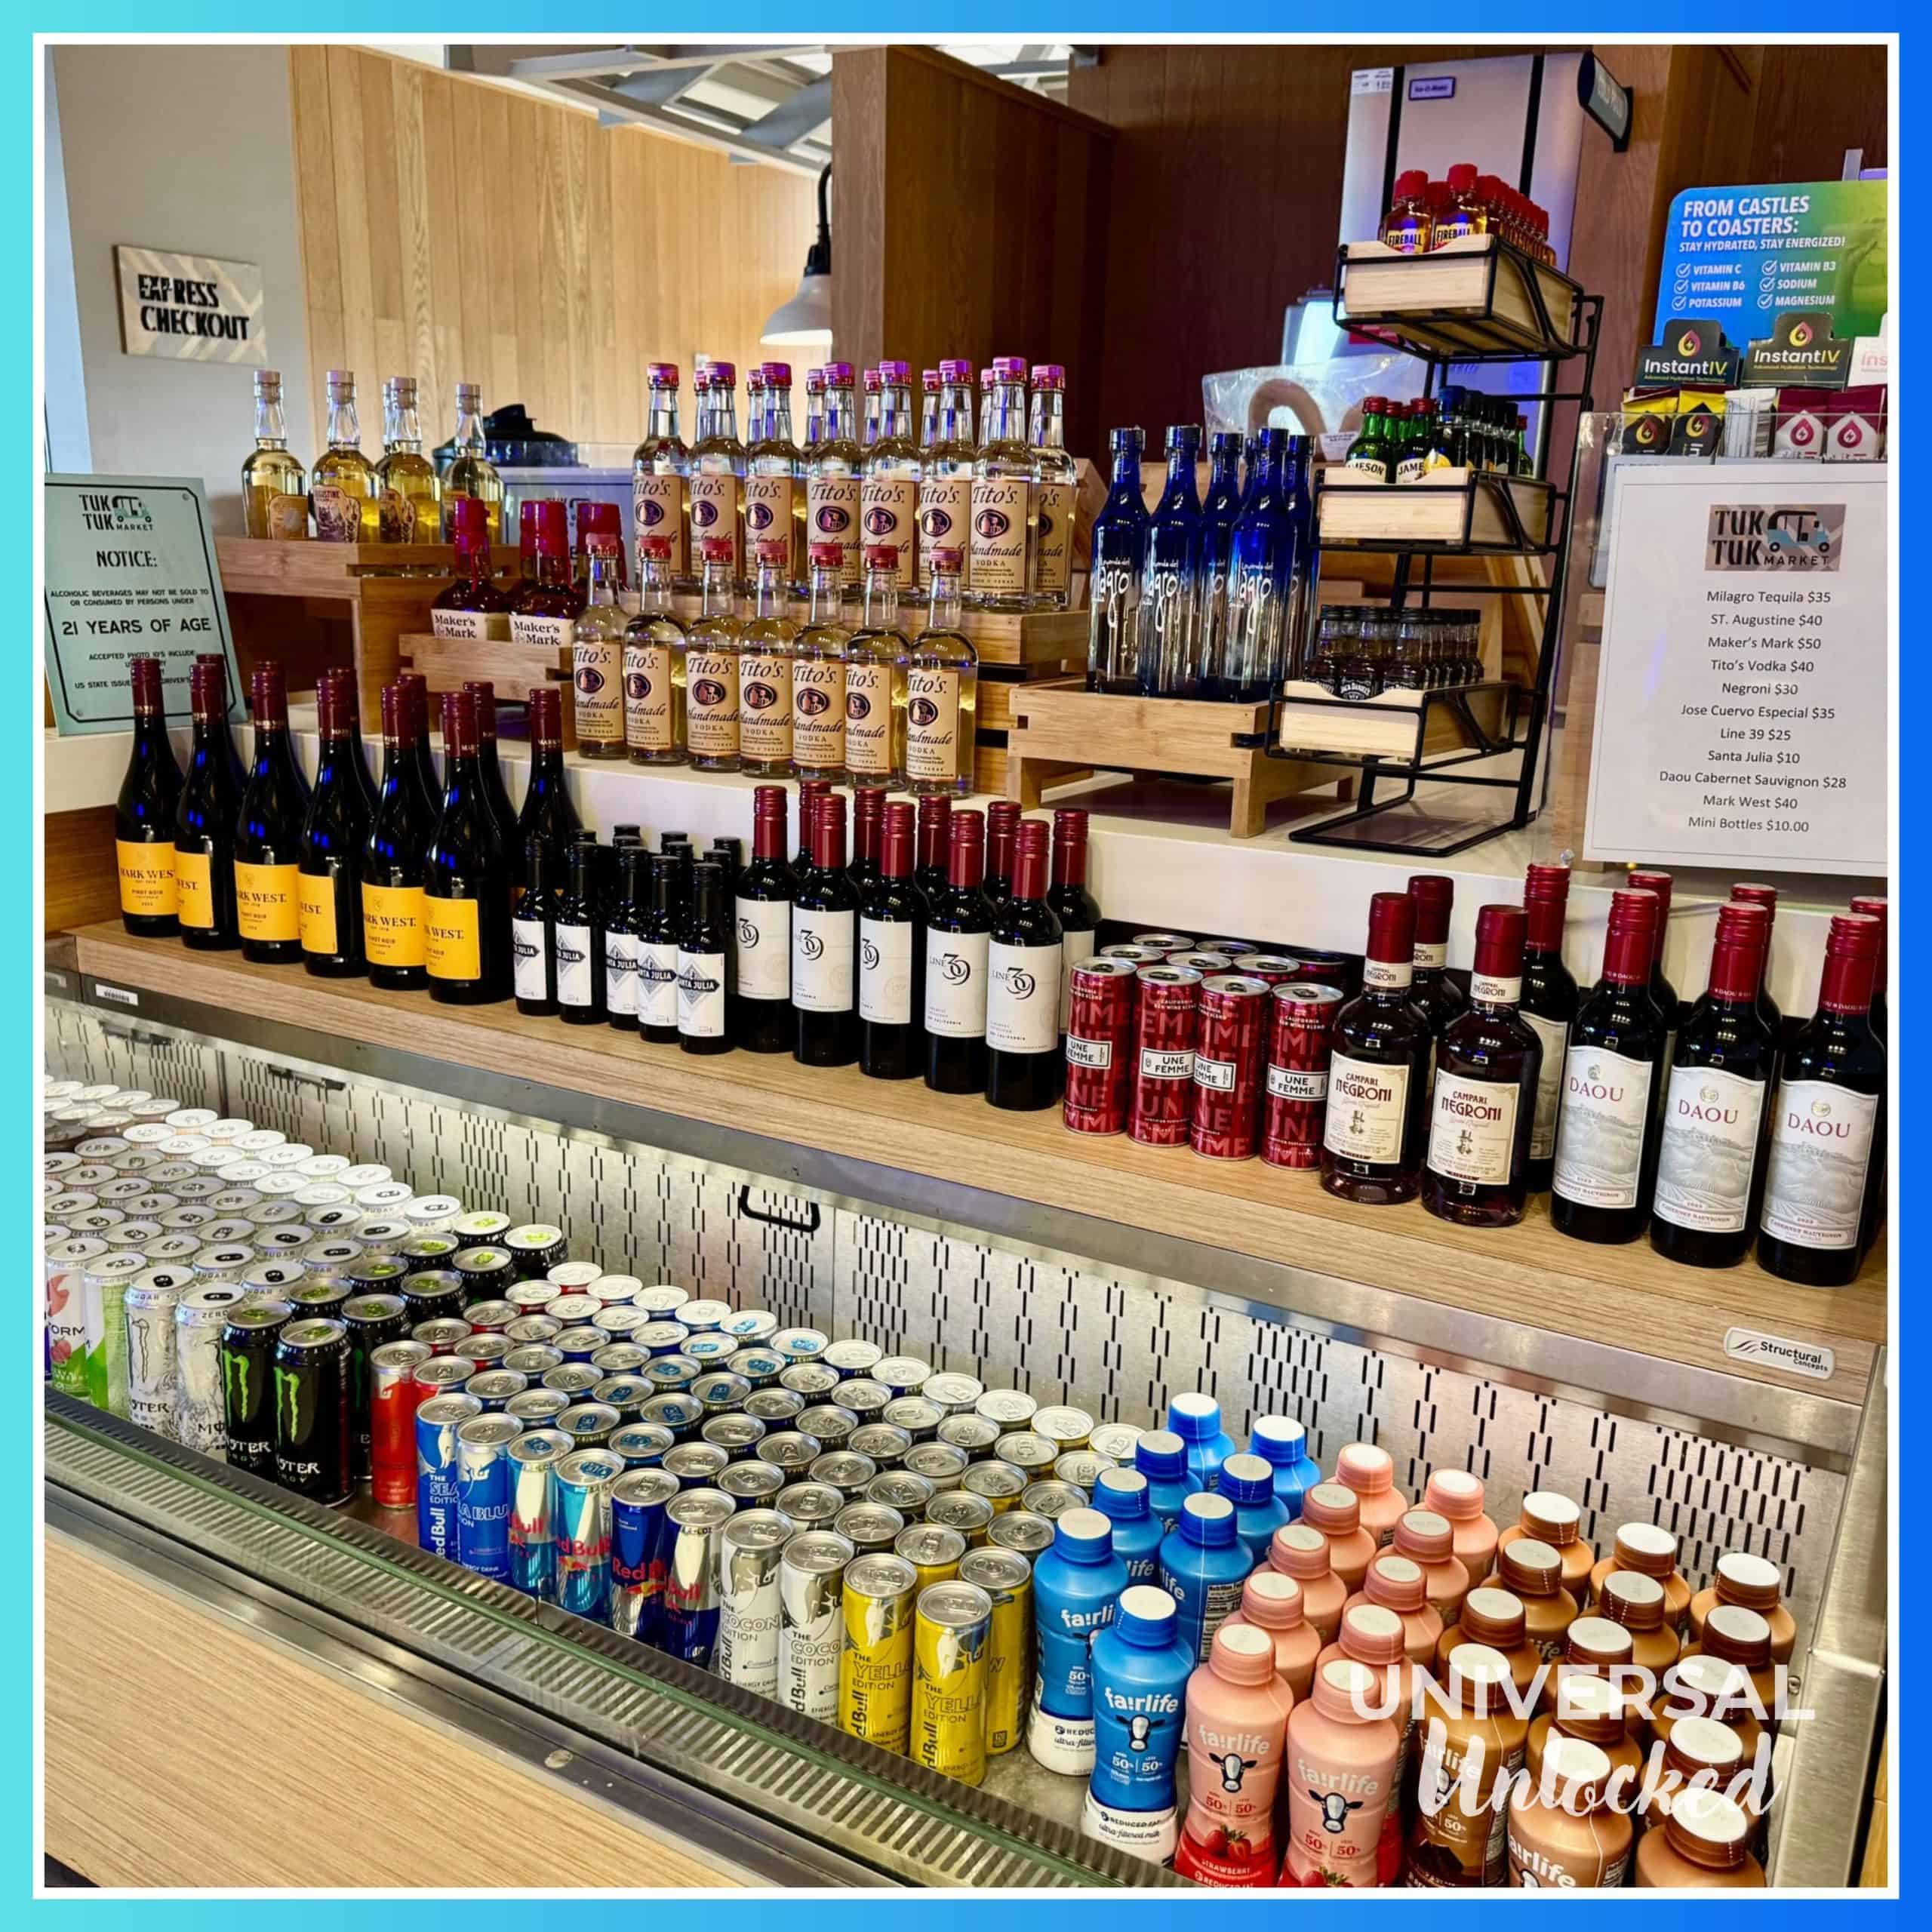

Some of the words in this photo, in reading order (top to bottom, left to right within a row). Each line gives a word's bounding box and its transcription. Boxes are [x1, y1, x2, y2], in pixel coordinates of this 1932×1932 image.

[1684, 200, 1733, 217] FROM
[1738, 195, 1810, 215] CASTLES
[1681, 220, 1702, 238] TO
[1707, 217, 1798, 236] COASTERS:
[1389, 234, 1422, 245] FIREBALL
[1679, 242, 1703, 252] STAY
[1704, 240, 1757, 251] HYDRATED,
[1760, 239, 1783, 249] STAY
[1786, 236, 1845, 248] ENERGIZED!
[1694, 265, 1733, 275] VITAMIN
[1735, 264, 1742, 274] C
[1780, 263, 1821, 272] VITAMIN
[1823, 262, 1836, 271] B3
[138, 274, 219, 307] EXPRESS
[1691, 281, 1730, 291] VITAMIN
[1733, 281, 1745, 290] B6
[1777, 279, 1817, 289] SODIUM
[1688, 298, 1742, 308] POTASSIUM
[1775, 296, 1835, 306] MAGNESIUM
[141, 306, 250, 340] CHECKOUT
[1754, 350, 1841, 362] InstantIV
[1644, 358, 1728, 375] InstantIV
[1398, 462, 1424, 475] JAME
[79, 495, 111, 512] TUK
[82, 513, 114, 530] TUK
[1715, 510, 1764, 535] TUK
[96, 550, 157, 568] NOTICE:
[1712, 540, 1761, 565] TUK
[1764, 555, 1829, 566] MARKET
[1707, 591, 1754, 604] Milagro
[1758, 591, 1804, 604] Tequila
[1807, 591, 1831, 603] $35
[62, 622, 78, 635] 21
[86, 620, 142, 634] YEARS
[150, 619, 171, 632] OF
[180, 618, 211, 631] AGE
[435, 615, 475, 626] Maker's
[514, 621, 560, 633] Maker's
[1711, 614, 1729, 625] ST.
[1732, 614, 1795, 627] Augustine
[1799, 614, 1823, 626] $40
[445, 626, 476, 638] Mark
[526, 633, 561, 645] Mark
[1708, 637, 1757, 648] Maker's
[1761, 638, 1793, 649] Mark
[1798, 638, 1821, 650] $50
[1711, 660, 1744, 671] Tito's
[1748, 660, 1786, 672] Vodka
[1790, 660, 1814, 672] $40
[1722, 683, 1770, 696] Negroni
[1774, 684, 1798, 696] $30
[1681, 705, 1707, 715] Jose
[1712, 705, 1754, 717] Cuervo
[1758, 706, 1807, 719] Especial
[1811, 708, 1835, 719] $35
[1720, 728, 1745, 739] Line
[1749, 729, 1764, 740] 39
[1768, 729, 1791, 741] $25
[1709, 751, 1742, 762] Santa
[1746, 752, 1773, 763] Julia
[1777, 752, 1799, 764] $10
[1660, 772, 1691, 783] Daou
[1695, 772, 1751, 785] Cabernet
[1755, 774, 1819, 789] Sauvignon
[1823, 777, 1847, 789] $28
[1703, 795, 1735, 807] Mark
[1739, 797, 1770, 808] West
[1774, 798, 1798, 809] $40
[1688, 817, 1715, 828] Mini
[1719, 818, 1762, 830] Bottles
[1766, 820, 1809, 832] $10.00
[146, 869, 175, 879] WES
[617, 960, 637, 969] JULIA
[652, 971, 672, 980] JULIA
[694, 981, 715, 990] JULIA
[1474, 985, 1506, 997] NEGRONI
[1071, 1041, 1088, 1051] UNE
[1068, 1048, 1094, 1062] FEMME
[1155, 1065, 1189, 1073] FEMME
[1285, 1075, 1309, 1085] UNE
[1346, 1073, 1378, 1086] CAMPARI
[1278, 1084, 1315, 1094] FEMME
[1336, 1079, 1392, 1102] NEGRONI
[1569, 1077, 1624, 1102] DAOU
[1453, 1091, 1487, 1104] CAMPARI
[1441, 1097, 1502, 1121] NEGRONI
[1678, 1099, 1738, 1124] DAOU
[1787, 1112, 1850, 1138] DAOU
[1760, 1341, 1822, 1364] Structural
[1794, 1358, 1828, 1371] Concepts
[472, 1504, 508, 1520] BLU
[613, 1558, 646, 1581] Red
[793, 1631, 812, 1641] THE
[791, 1640, 841, 1656] COCO
[791, 1656, 835, 1667] EDITION
[854, 1652, 871, 1663] THE
[855, 1661, 906, 1680] YELL
[852, 1678, 894, 1690] EDITION
[1110, 1817, 1147, 1827] REDUCED
[1201, 1860, 1250, 1874] STRAWBERRY
